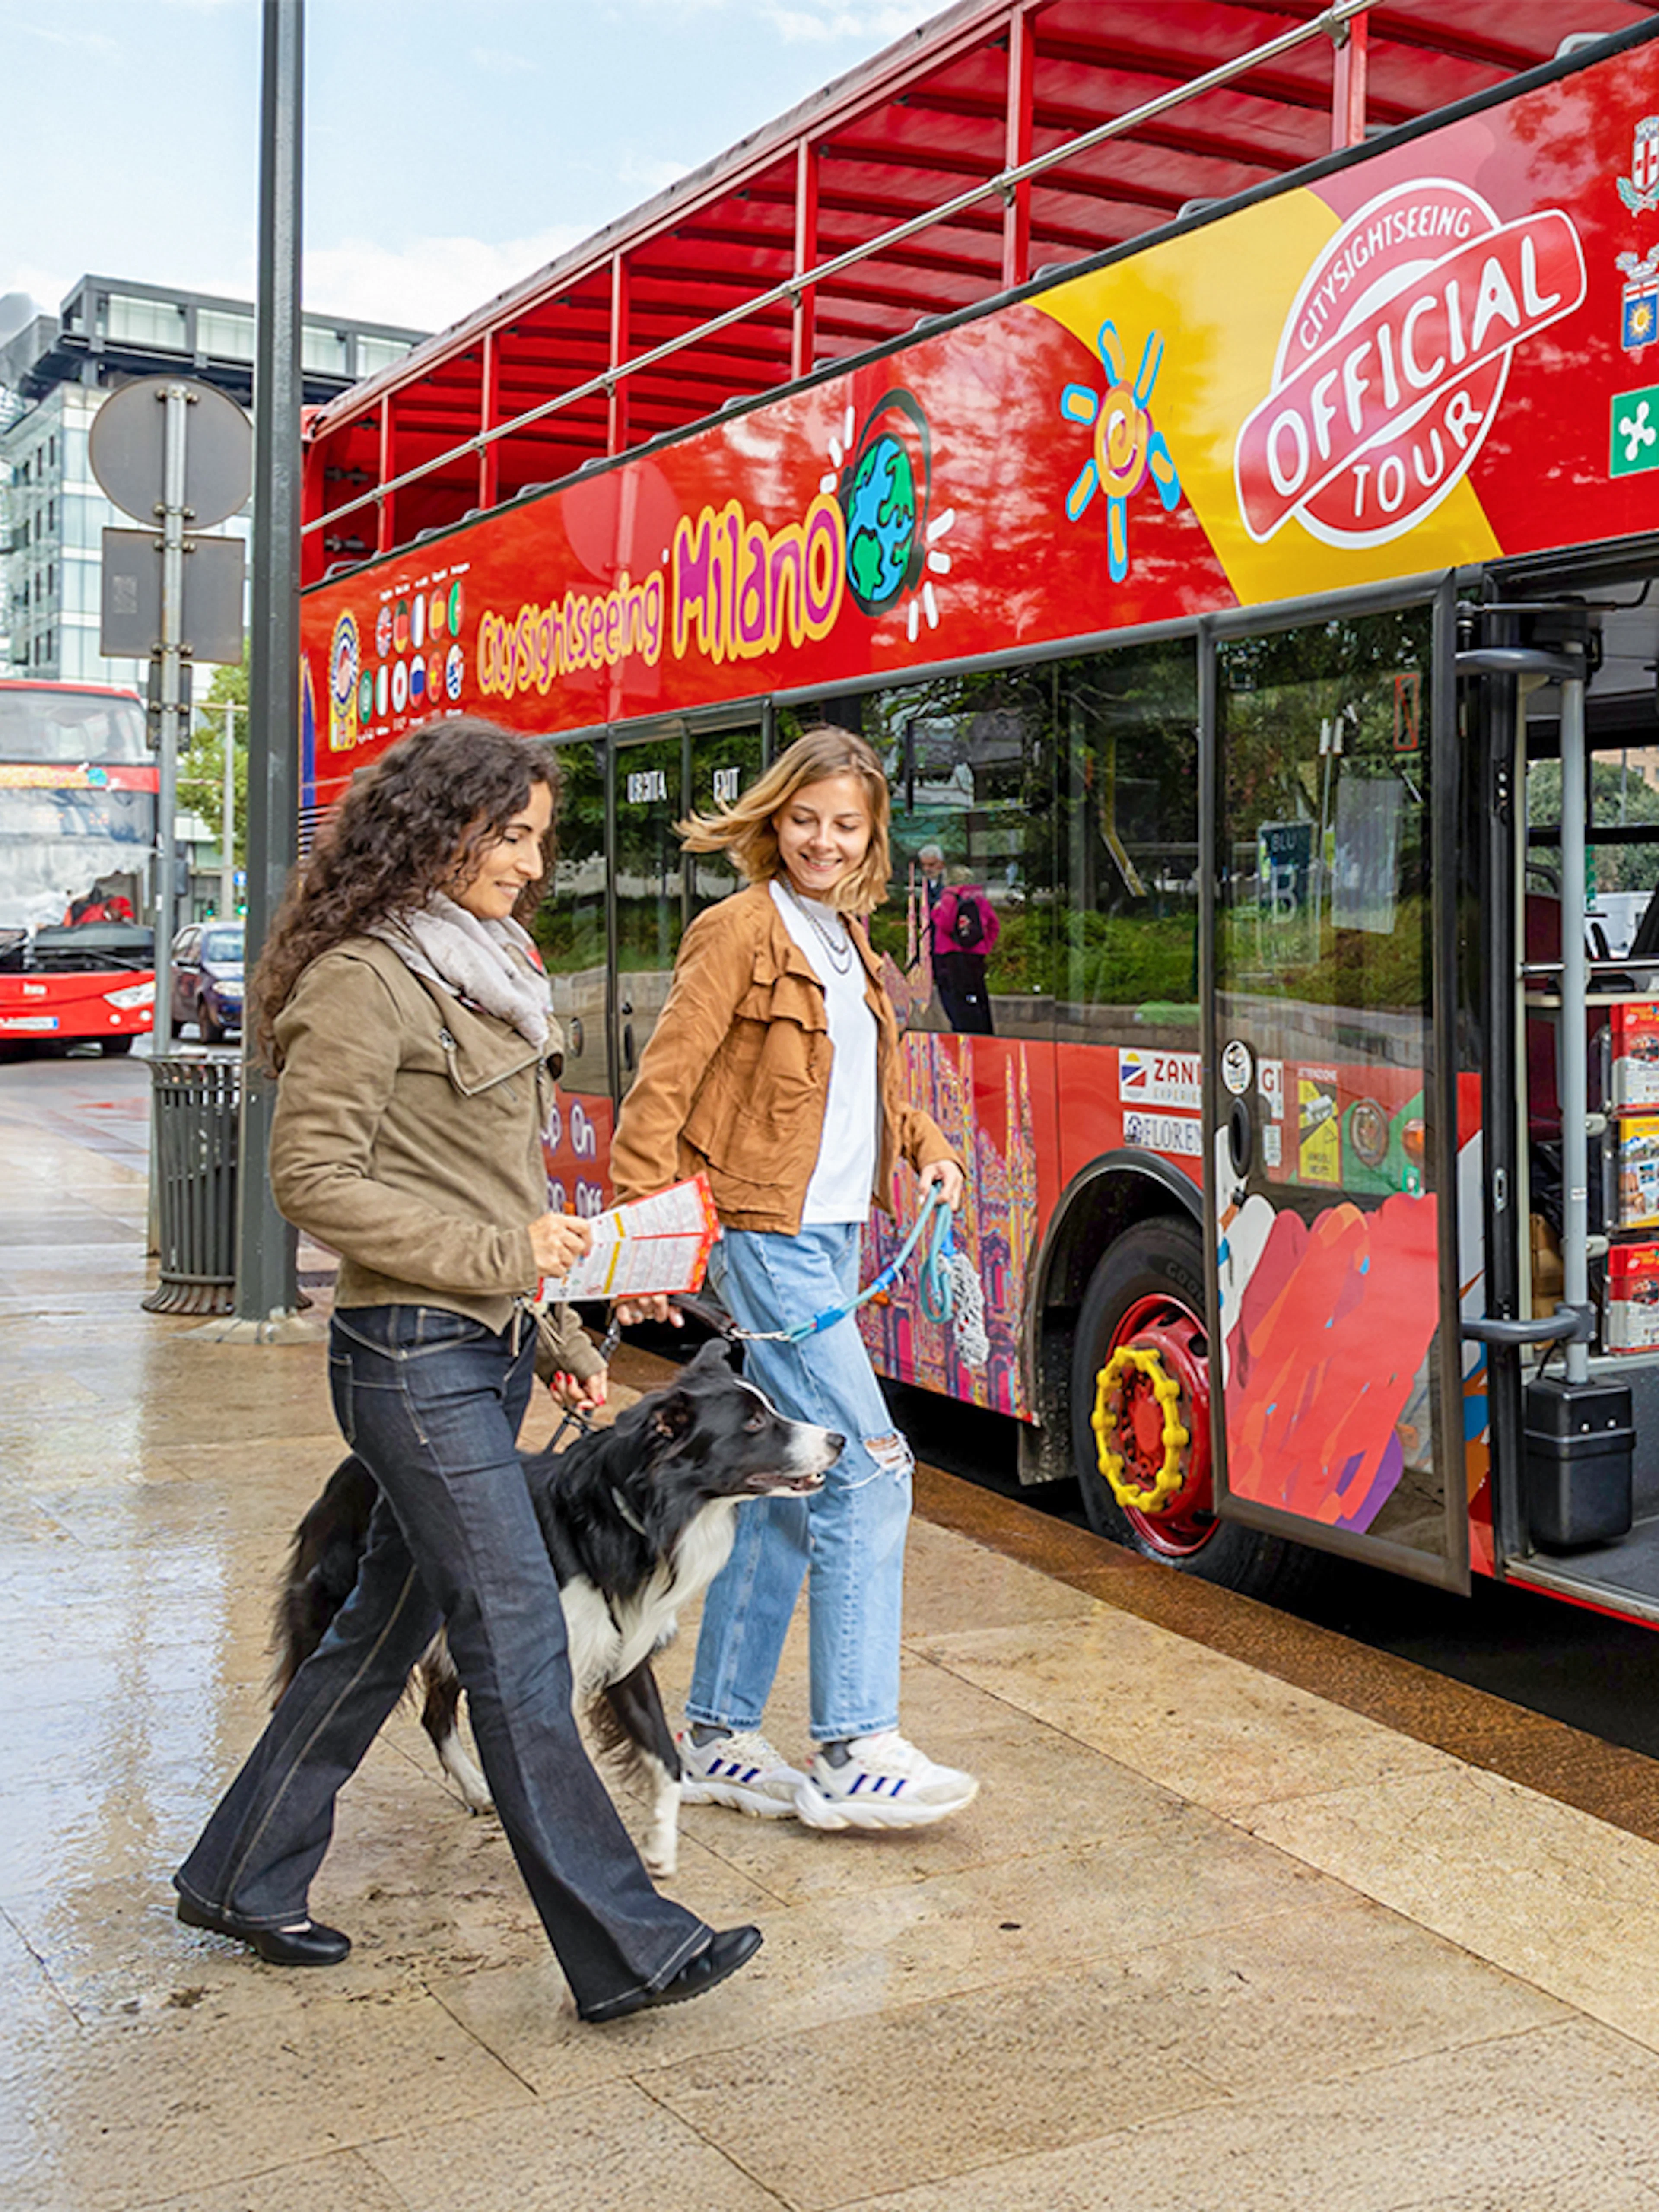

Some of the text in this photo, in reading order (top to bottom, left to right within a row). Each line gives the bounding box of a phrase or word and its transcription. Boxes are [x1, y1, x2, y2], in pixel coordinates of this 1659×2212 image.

[1299, 205, 1472, 350] CITYSIGHTSEEING
[1267, 235, 1561, 497] OFFICIAL
[1352, 390, 1483, 517] TOUR
[672, 493, 846, 664] Milano
[570, 1103, 596, 1156] On
